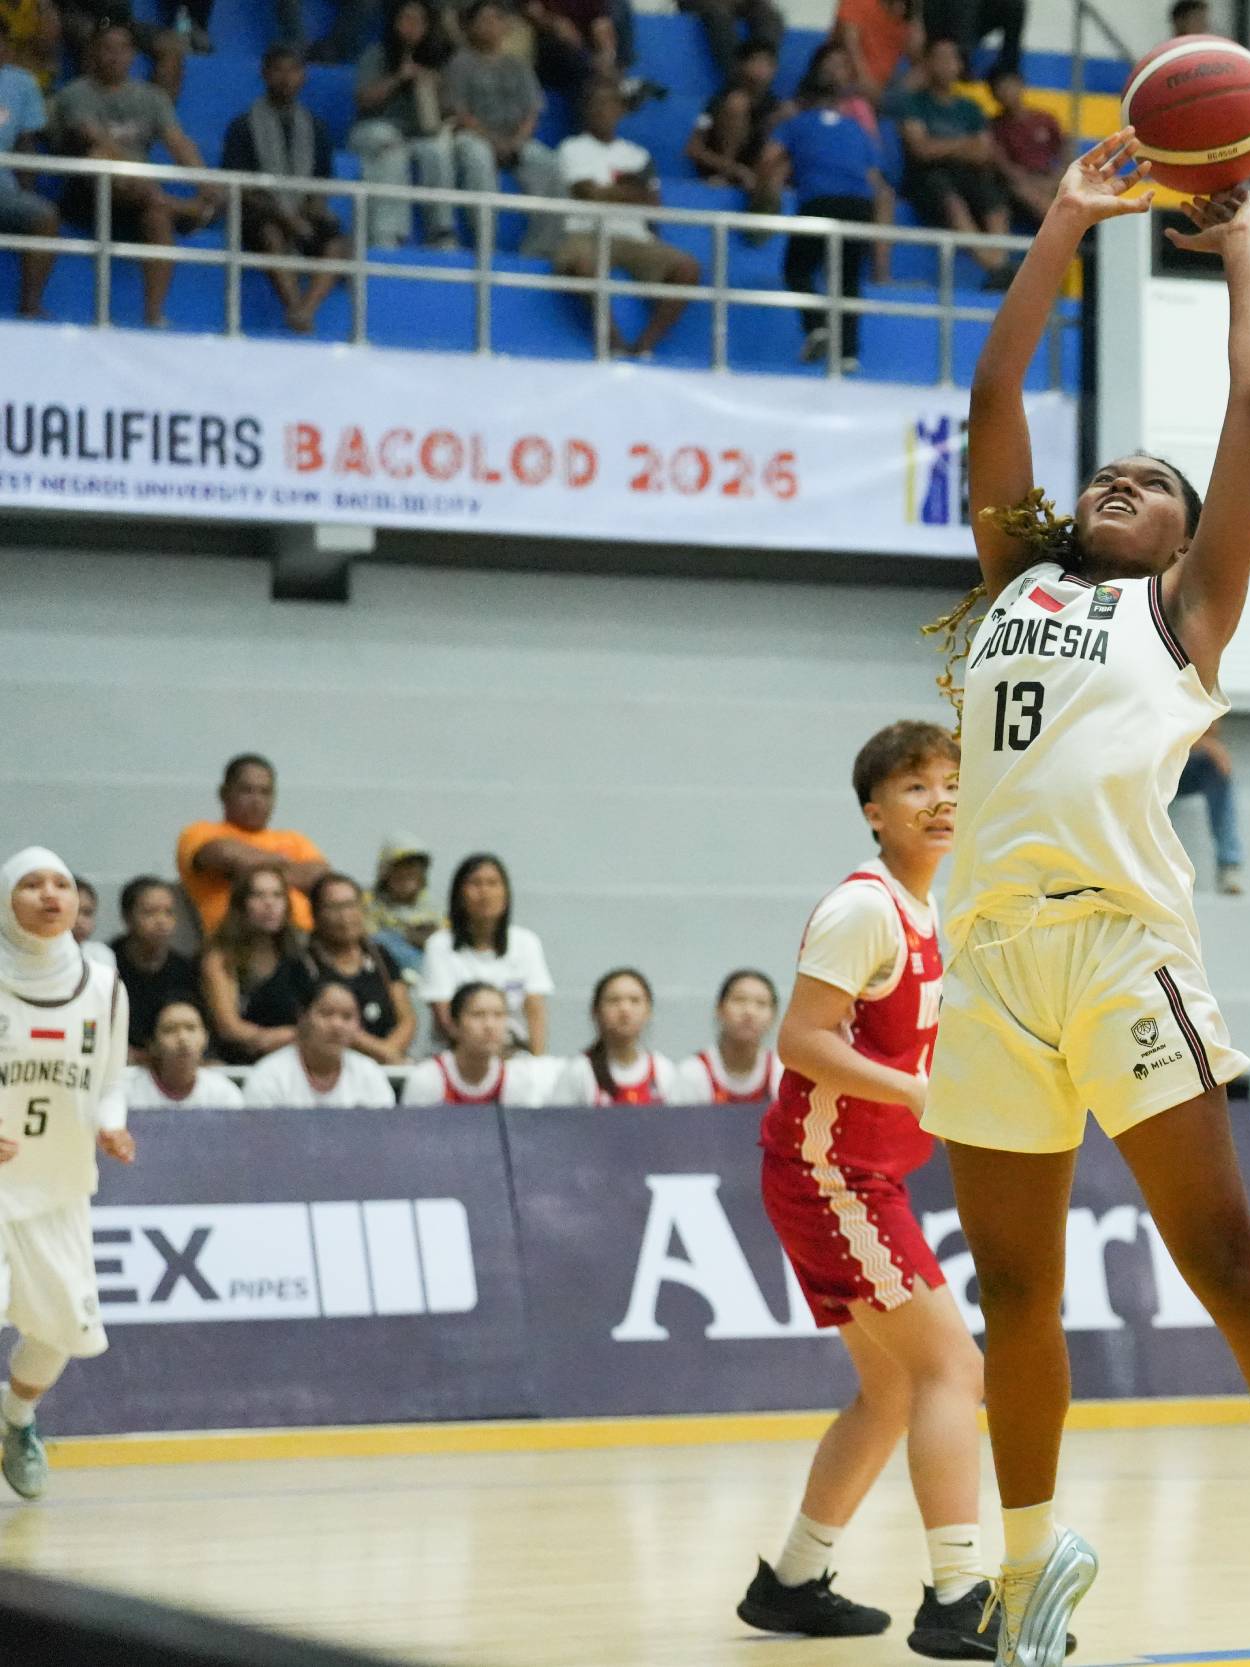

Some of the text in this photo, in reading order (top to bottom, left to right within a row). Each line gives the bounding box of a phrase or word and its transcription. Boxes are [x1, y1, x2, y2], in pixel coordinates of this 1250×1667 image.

[0, 402, 799, 500] UALIFIERS BACOLOD 2026
[993, 681, 1045, 752] 13
[1151, 1051, 1184, 1071] MILLS
[24, 1098, 51, 1136] 5
[228, 1277, 310, 1301] PIPES
